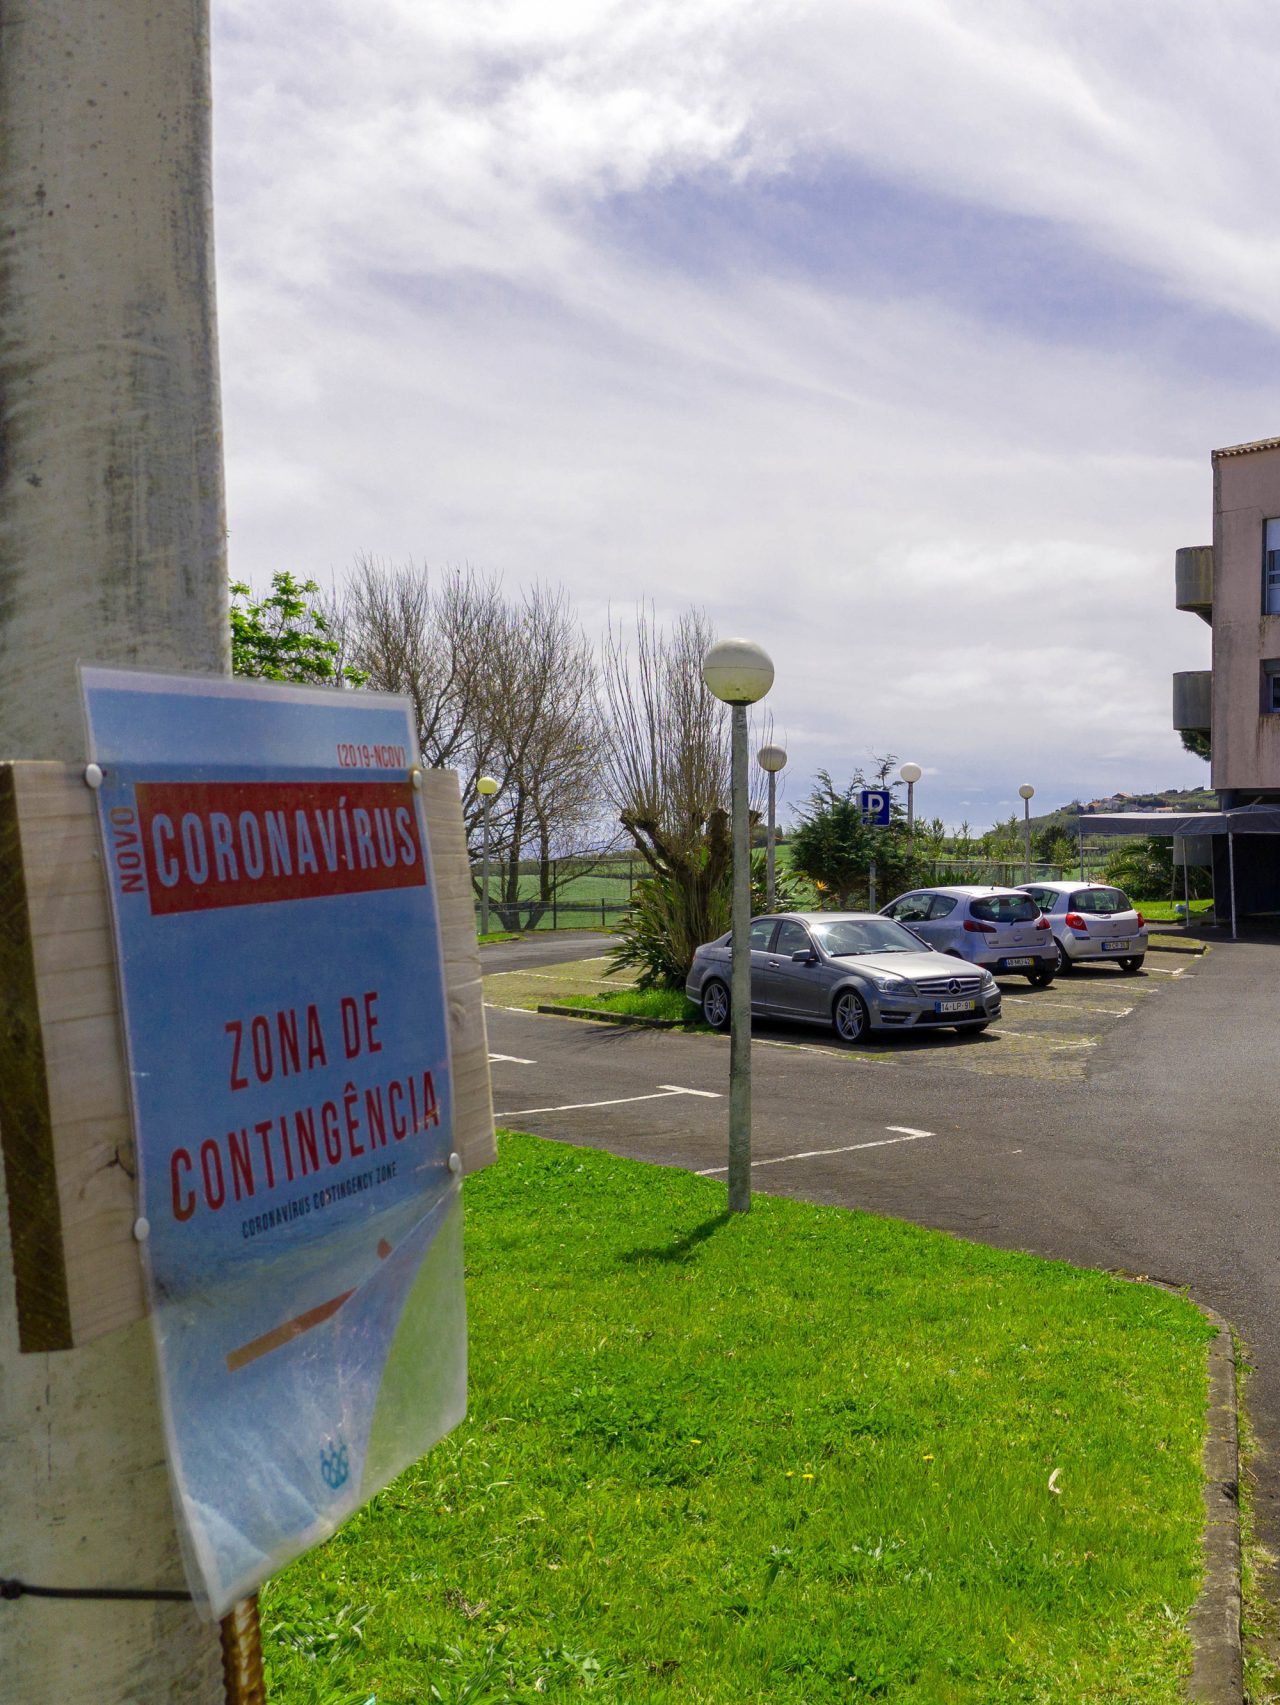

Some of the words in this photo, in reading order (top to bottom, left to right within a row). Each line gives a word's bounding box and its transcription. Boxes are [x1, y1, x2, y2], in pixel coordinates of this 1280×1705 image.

[152, 796, 417, 888] CORONAVÍRUS
[868, 794, 884, 817] P
[109, 807, 145, 894] NOVO
[225, 1003, 327, 1091] ZONA
[340, 991, 382, 1060] DE
[170, 1070, 440, 1222] CONTINGÊNCIA
[375, 1161, 398, 1184] ZONE
